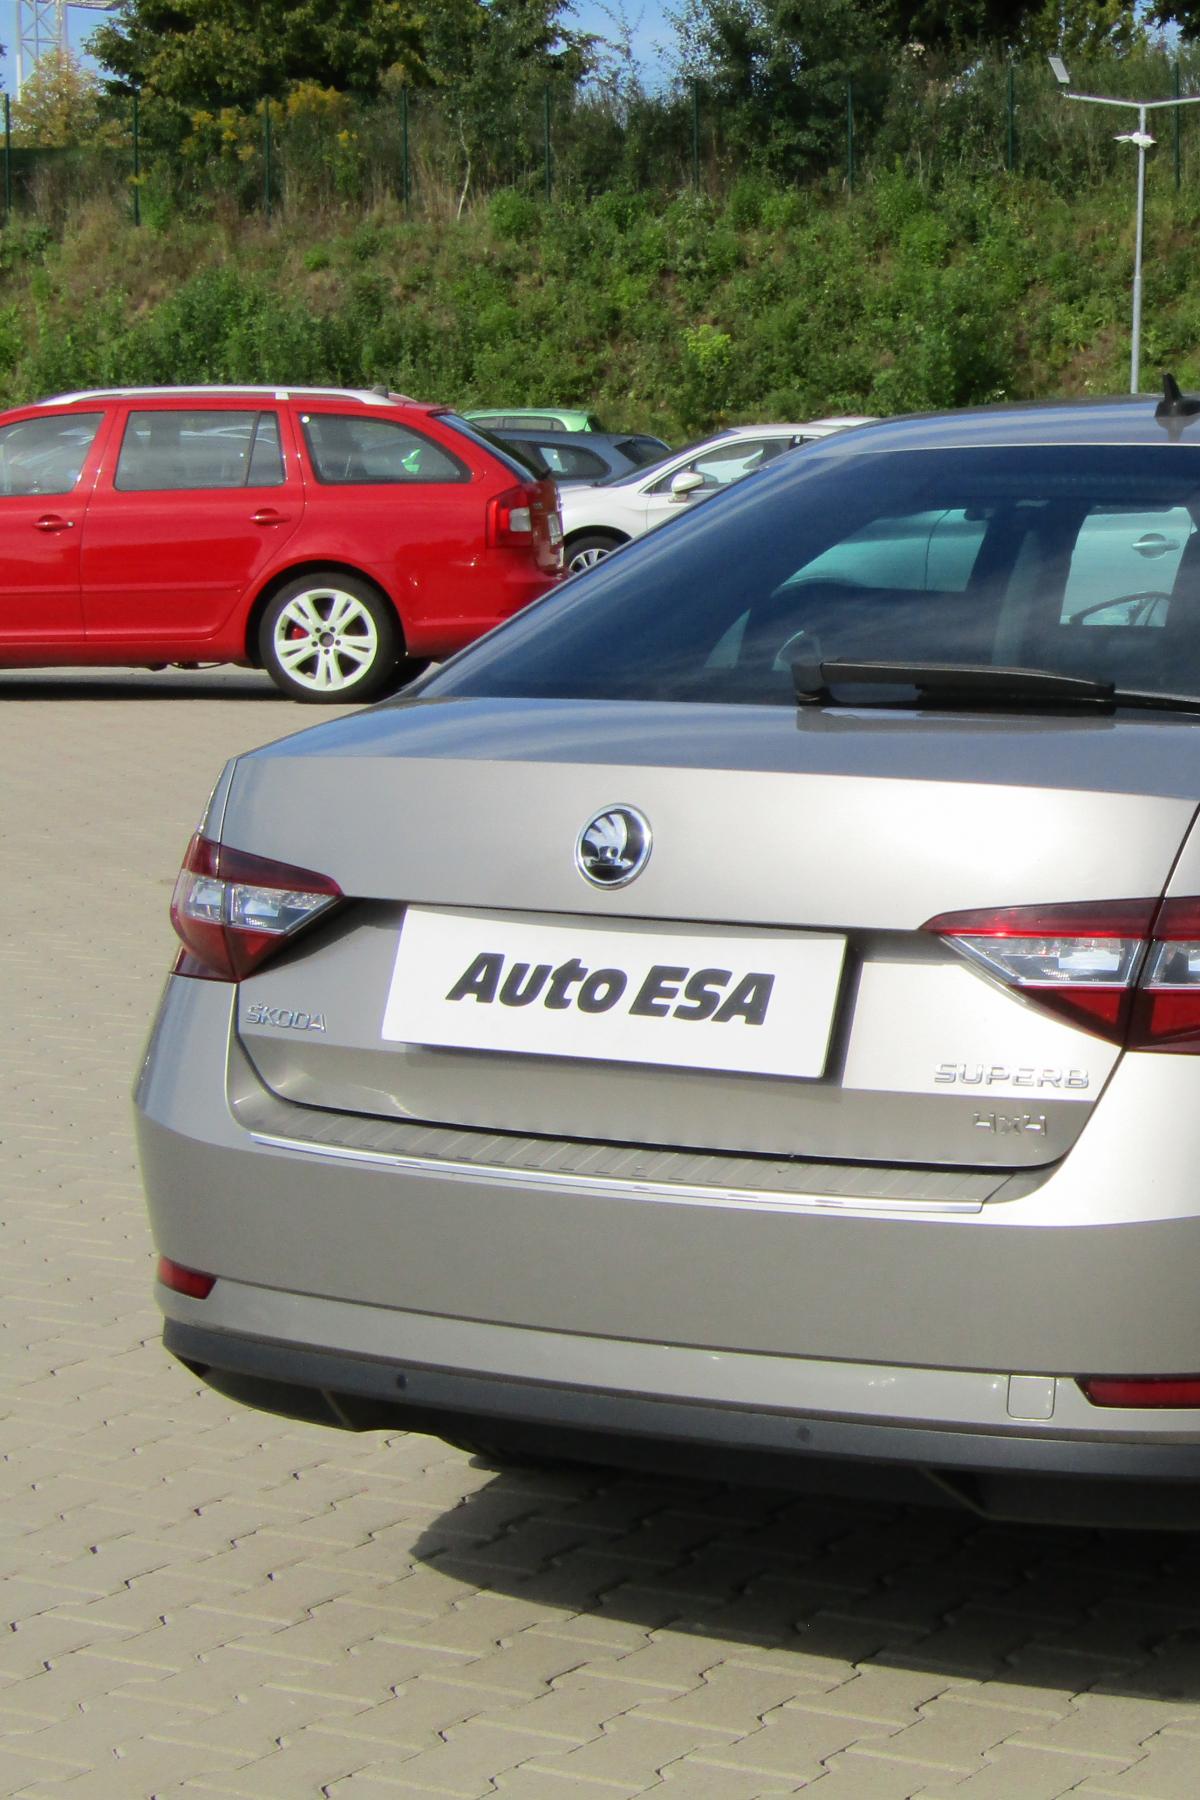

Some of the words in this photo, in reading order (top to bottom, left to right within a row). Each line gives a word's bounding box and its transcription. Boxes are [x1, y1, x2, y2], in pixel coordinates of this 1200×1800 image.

[445, 952, 628, 1014] Auto
[628, 965, 775, 1026] ESA
[934, 1063, 1090, 1089] SUPERB
